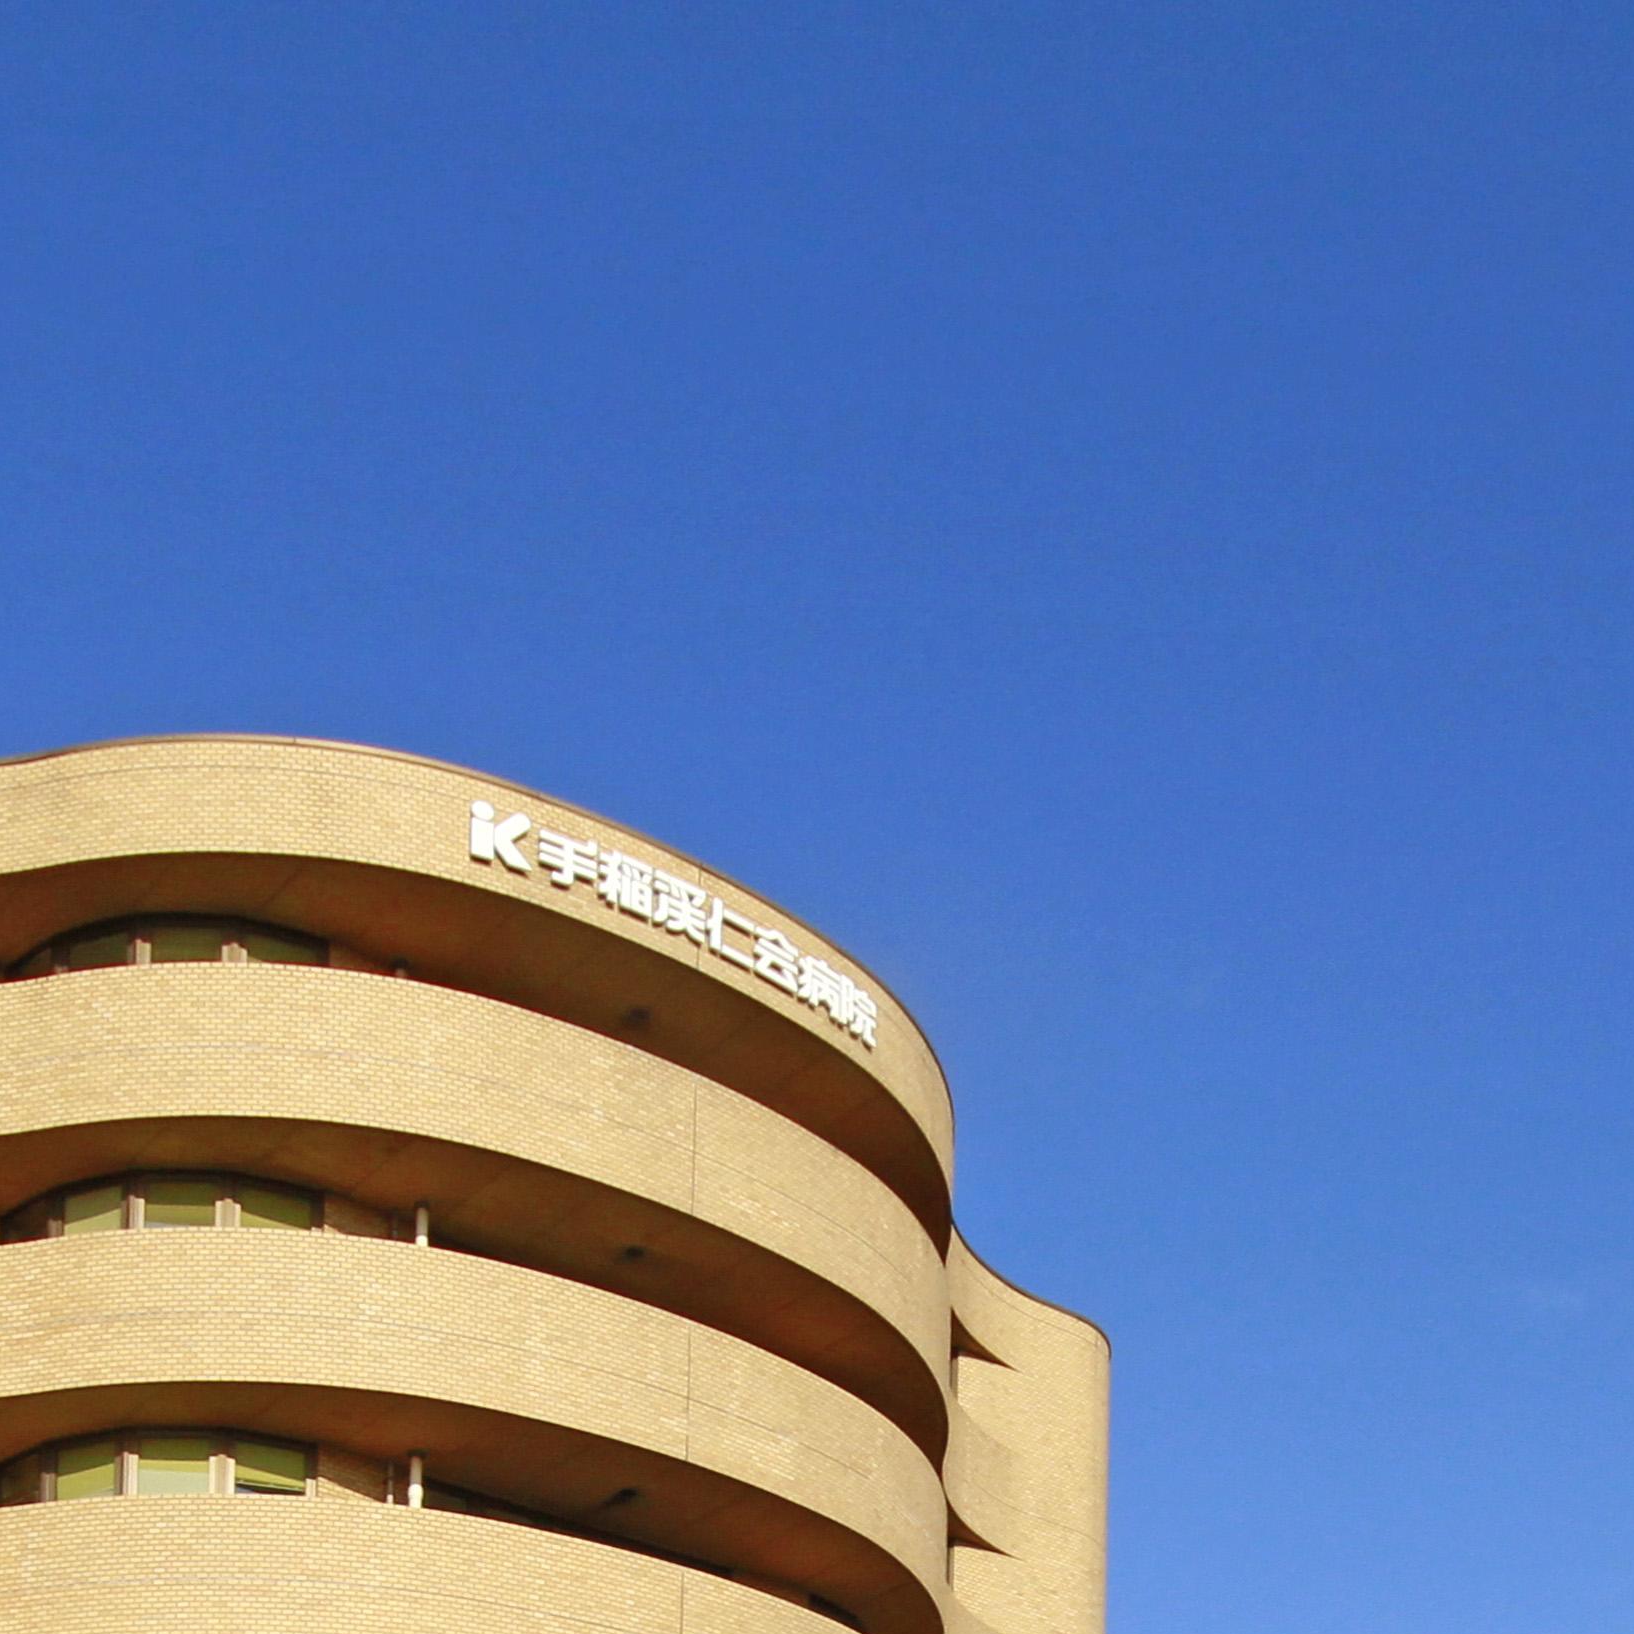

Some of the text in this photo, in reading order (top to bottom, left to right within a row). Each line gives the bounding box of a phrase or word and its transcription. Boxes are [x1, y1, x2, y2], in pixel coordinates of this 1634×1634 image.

[538, 829, 878, 1049] 手稲渓仁会病院
